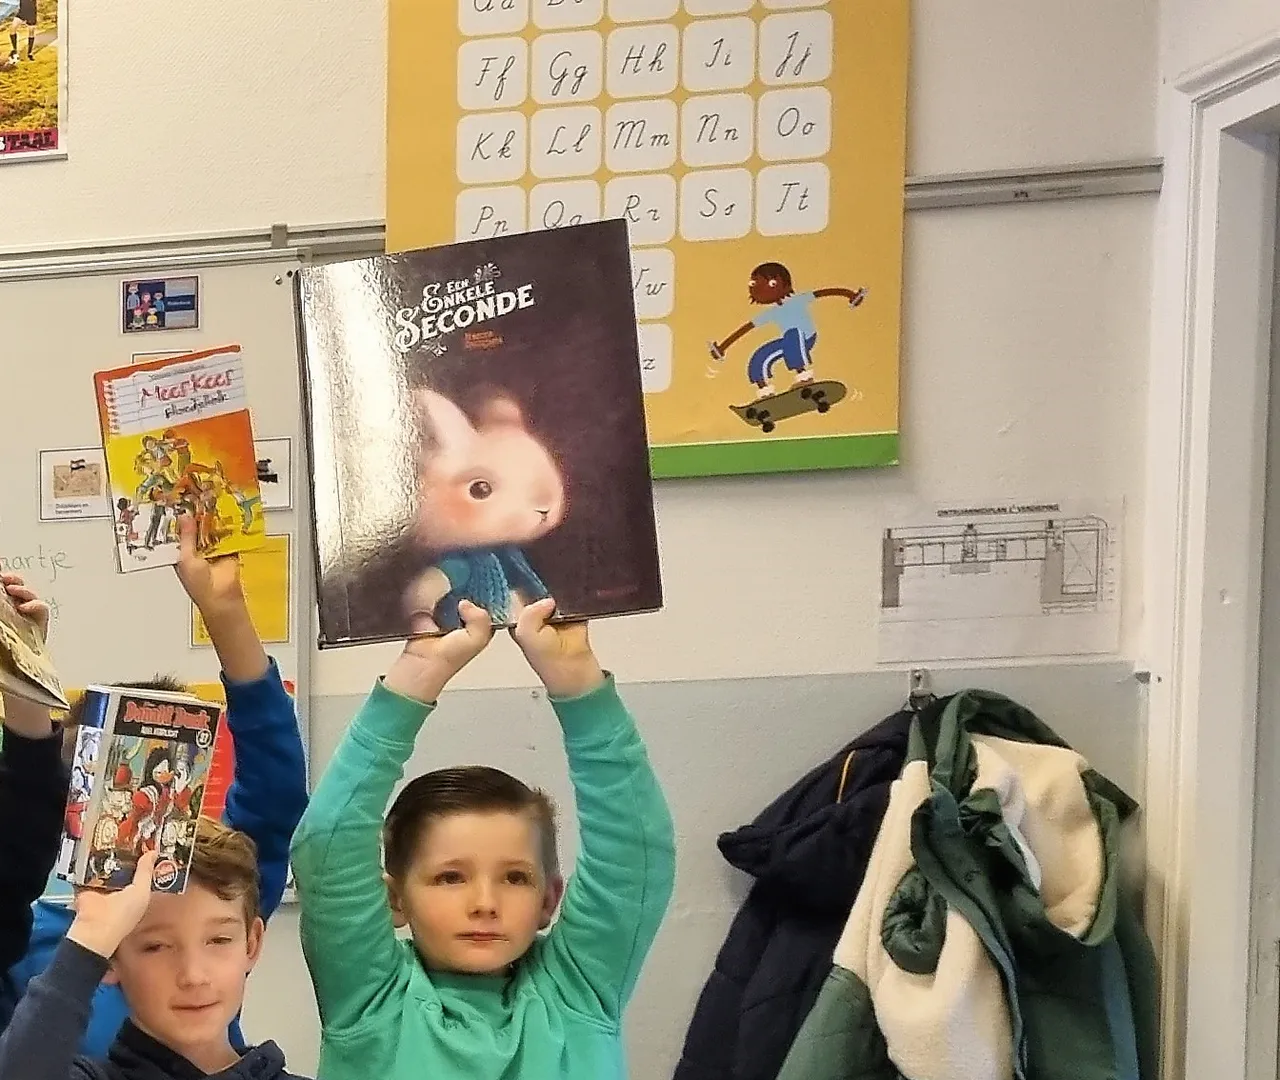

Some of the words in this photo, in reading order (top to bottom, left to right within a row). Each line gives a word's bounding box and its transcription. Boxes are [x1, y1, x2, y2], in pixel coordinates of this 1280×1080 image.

[476, 55, 516, 101] Ff
[548, 50, 590, 97] Gg
[620, 43, 666, 77] Hh
[470, 127, 513, 162] Kk
[546, 122, 588, 157] Ll
[613, 118, 671, 152] Mm
[696, 113, 739, 146] Nn
[777, 106, 816, 139] Oo
[699, 188, 735, 220] Ss
[777, 181, 810, 214] Tt
[394, 284, 536, 355] SECONDE
[421, 281, 495, 312] ENKELE
